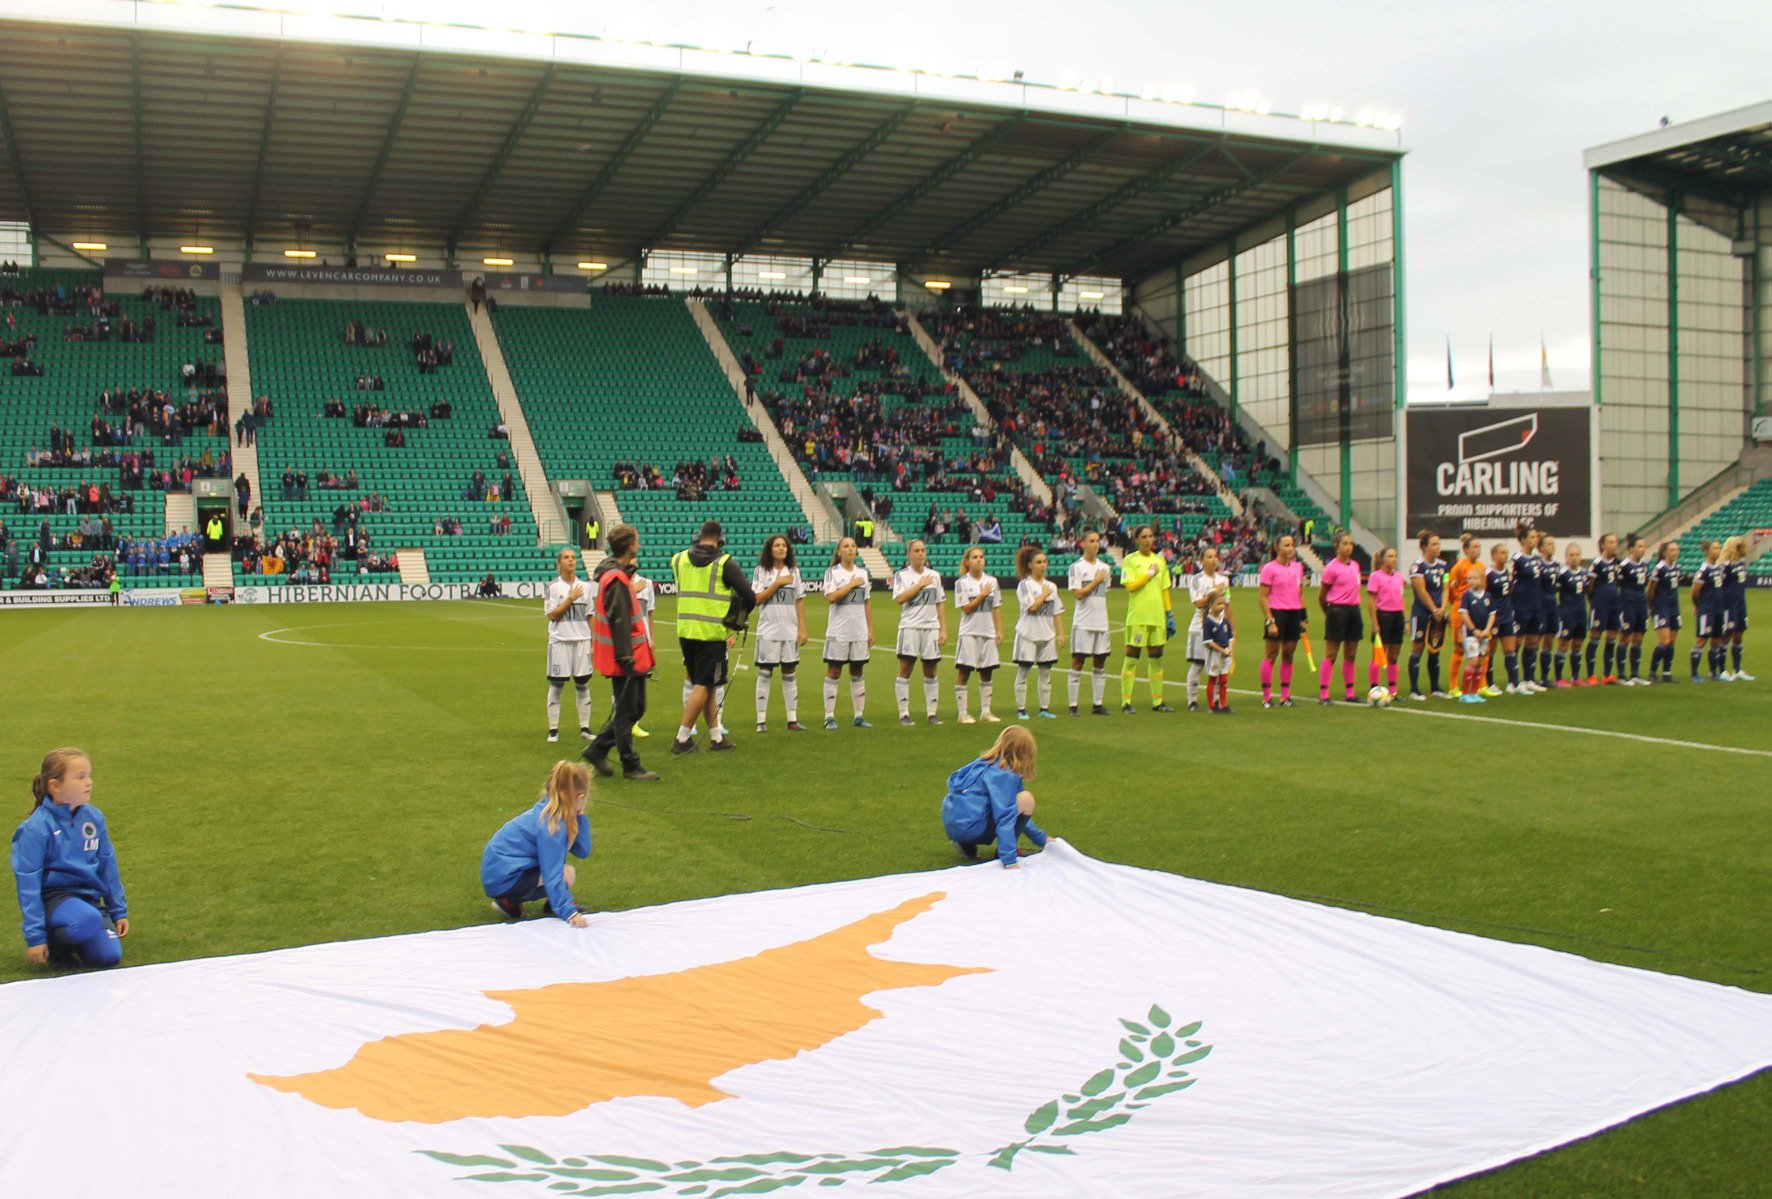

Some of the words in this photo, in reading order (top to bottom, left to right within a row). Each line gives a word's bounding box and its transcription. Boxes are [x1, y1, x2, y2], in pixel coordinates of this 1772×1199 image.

[266, 268, 441, 284] WWW.LEVENCARCOMPANY.CO.UK
[1437, 460, 1559, 496] CARLING
[1438, 503, 1473, 516] PROUD
[1475, 503, 1542, 516] SUPPORTERS
[1544, 503, 1559, 516] OF
[1433, 575, 1441, 588] 4
[267, 585, 390, 603] HIBERNIAN
[1502, 582, 1509, 595] 2
[13, 596, 52, 604] BUILDING
[54, 595, 93, 603] SUPPLIES
[776, 589, 786, 602] 19
